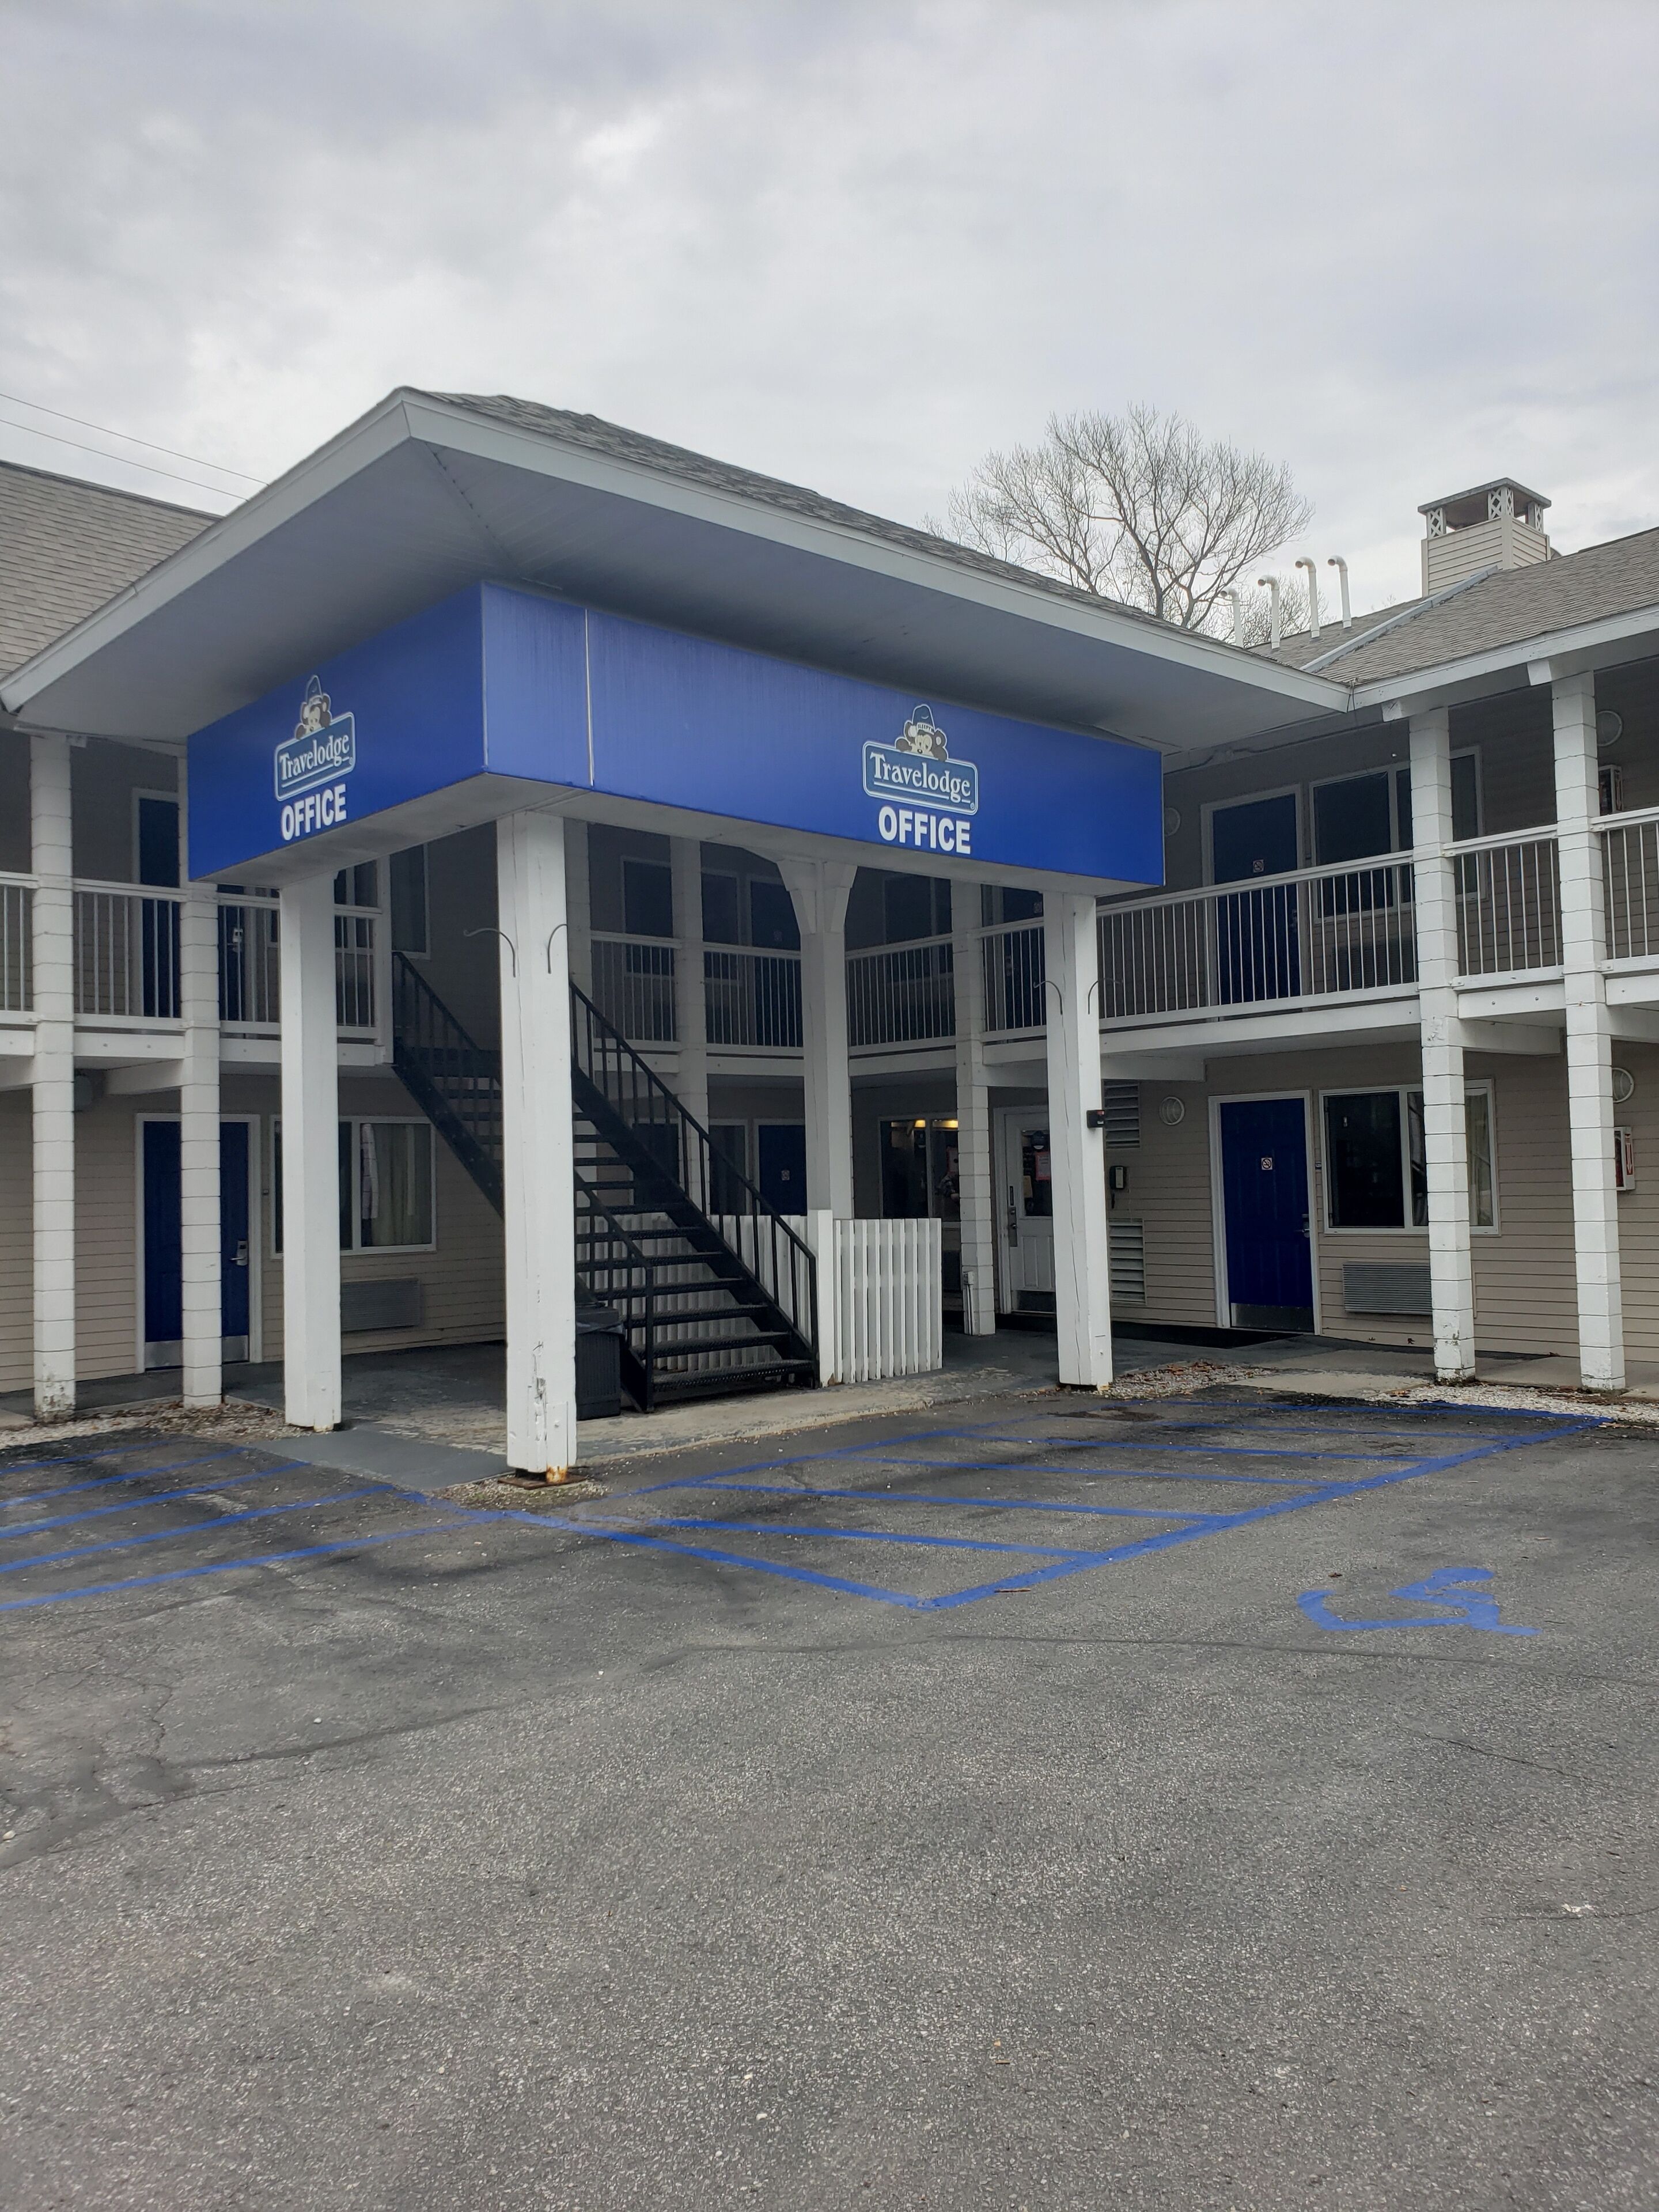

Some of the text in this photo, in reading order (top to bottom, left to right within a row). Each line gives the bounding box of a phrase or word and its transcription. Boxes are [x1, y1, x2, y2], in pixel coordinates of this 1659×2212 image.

[279, 735, 350, 780] Travelodge
[870, 752, 971, 802] Travelodge
[282, 784, 347, 840] OFFICE
[879, 806, 971, 854] OFFICE
